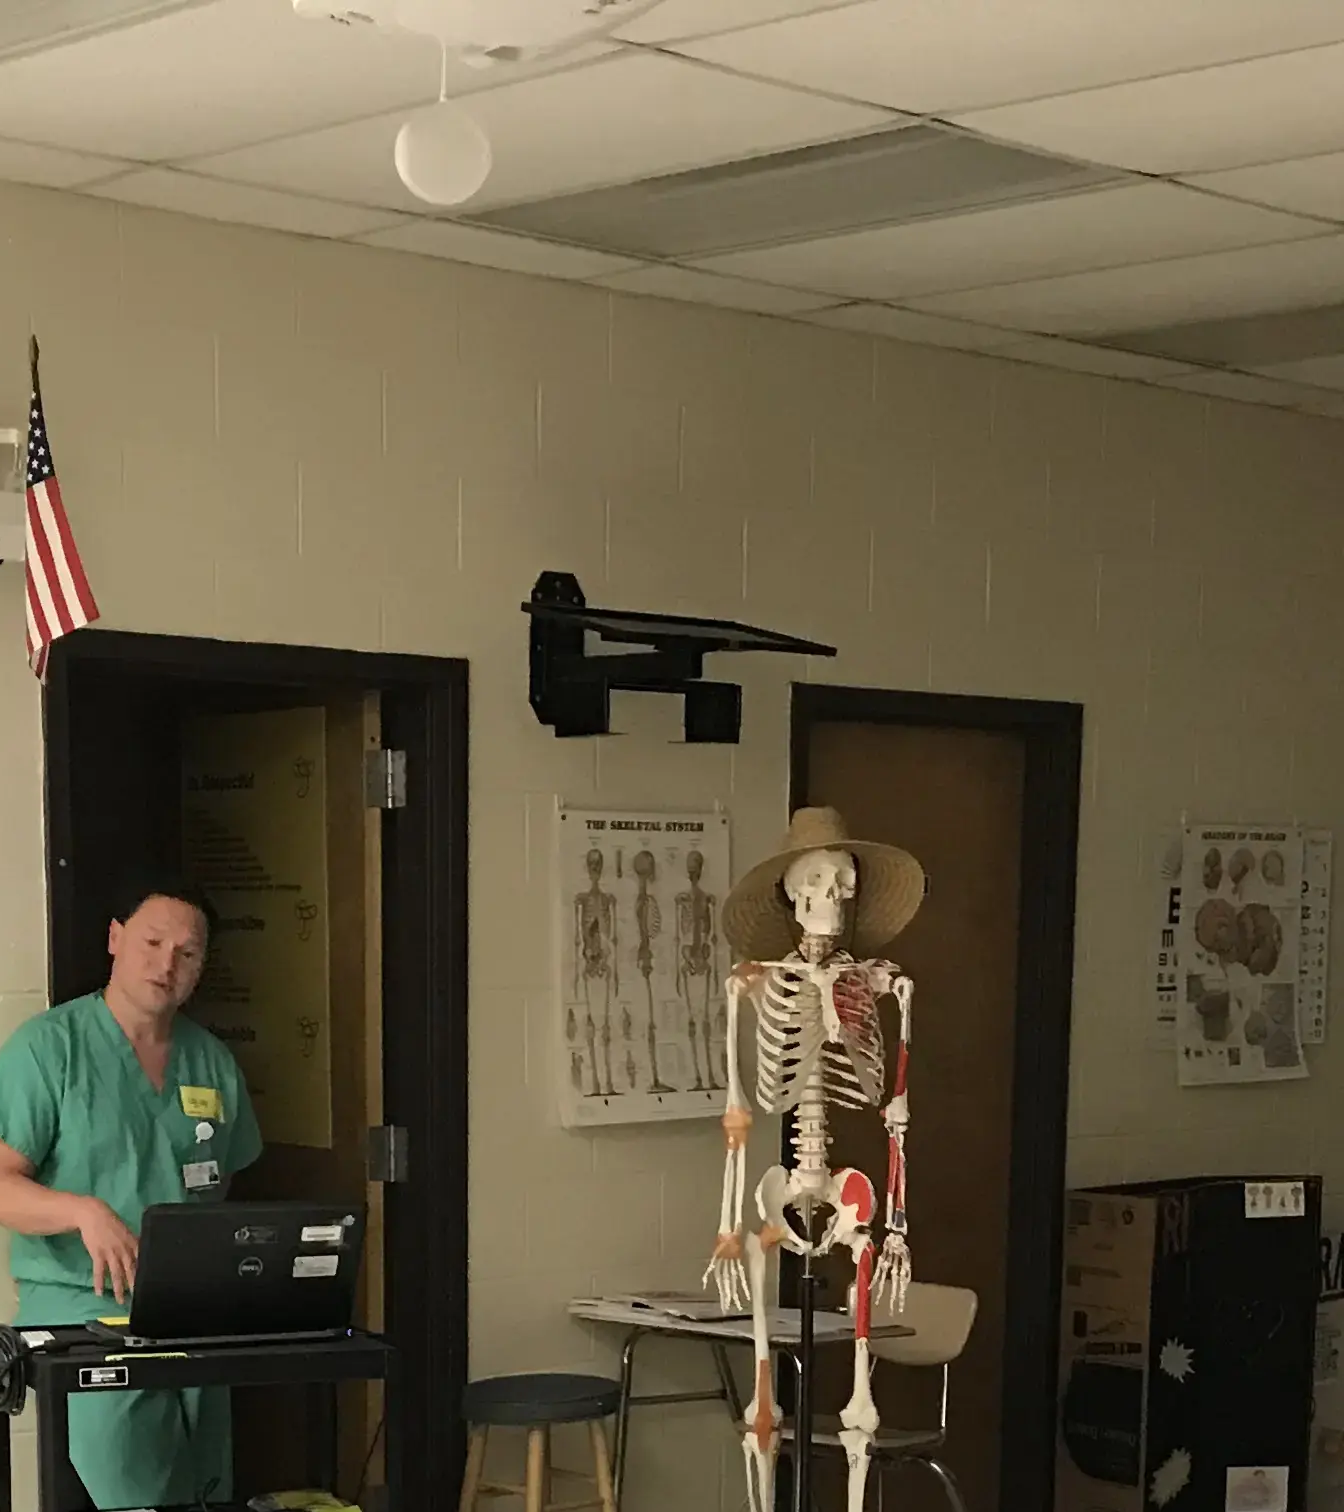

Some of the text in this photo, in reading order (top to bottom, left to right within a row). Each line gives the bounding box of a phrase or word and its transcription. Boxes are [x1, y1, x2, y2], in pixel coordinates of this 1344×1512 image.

[585, 819, 704, 832] THE SKELETAL SYSTEM
